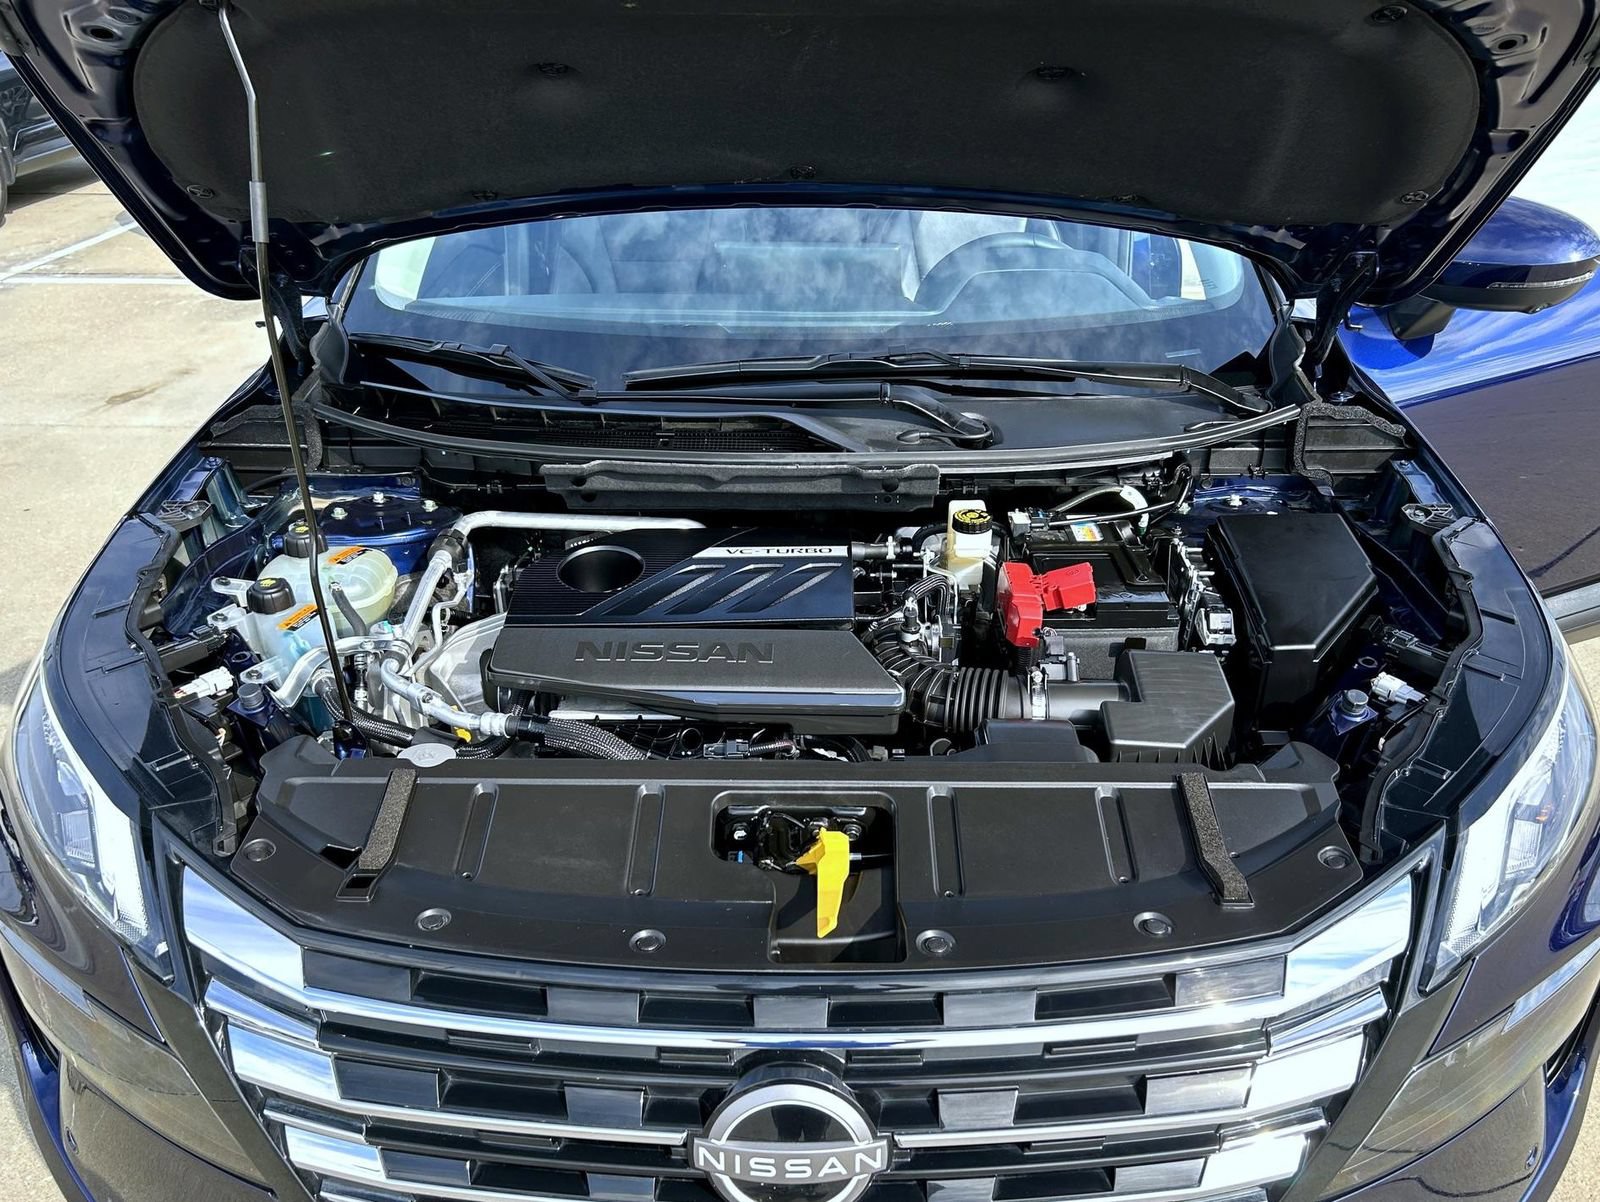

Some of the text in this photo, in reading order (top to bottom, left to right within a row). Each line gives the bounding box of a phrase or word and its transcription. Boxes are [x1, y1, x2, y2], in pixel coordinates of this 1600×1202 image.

[726, 547, 832, 555] VC-TURBO
[575, 641, 774, 663] NISSAN
[699, 1147, 882, 1178] NISSAN
